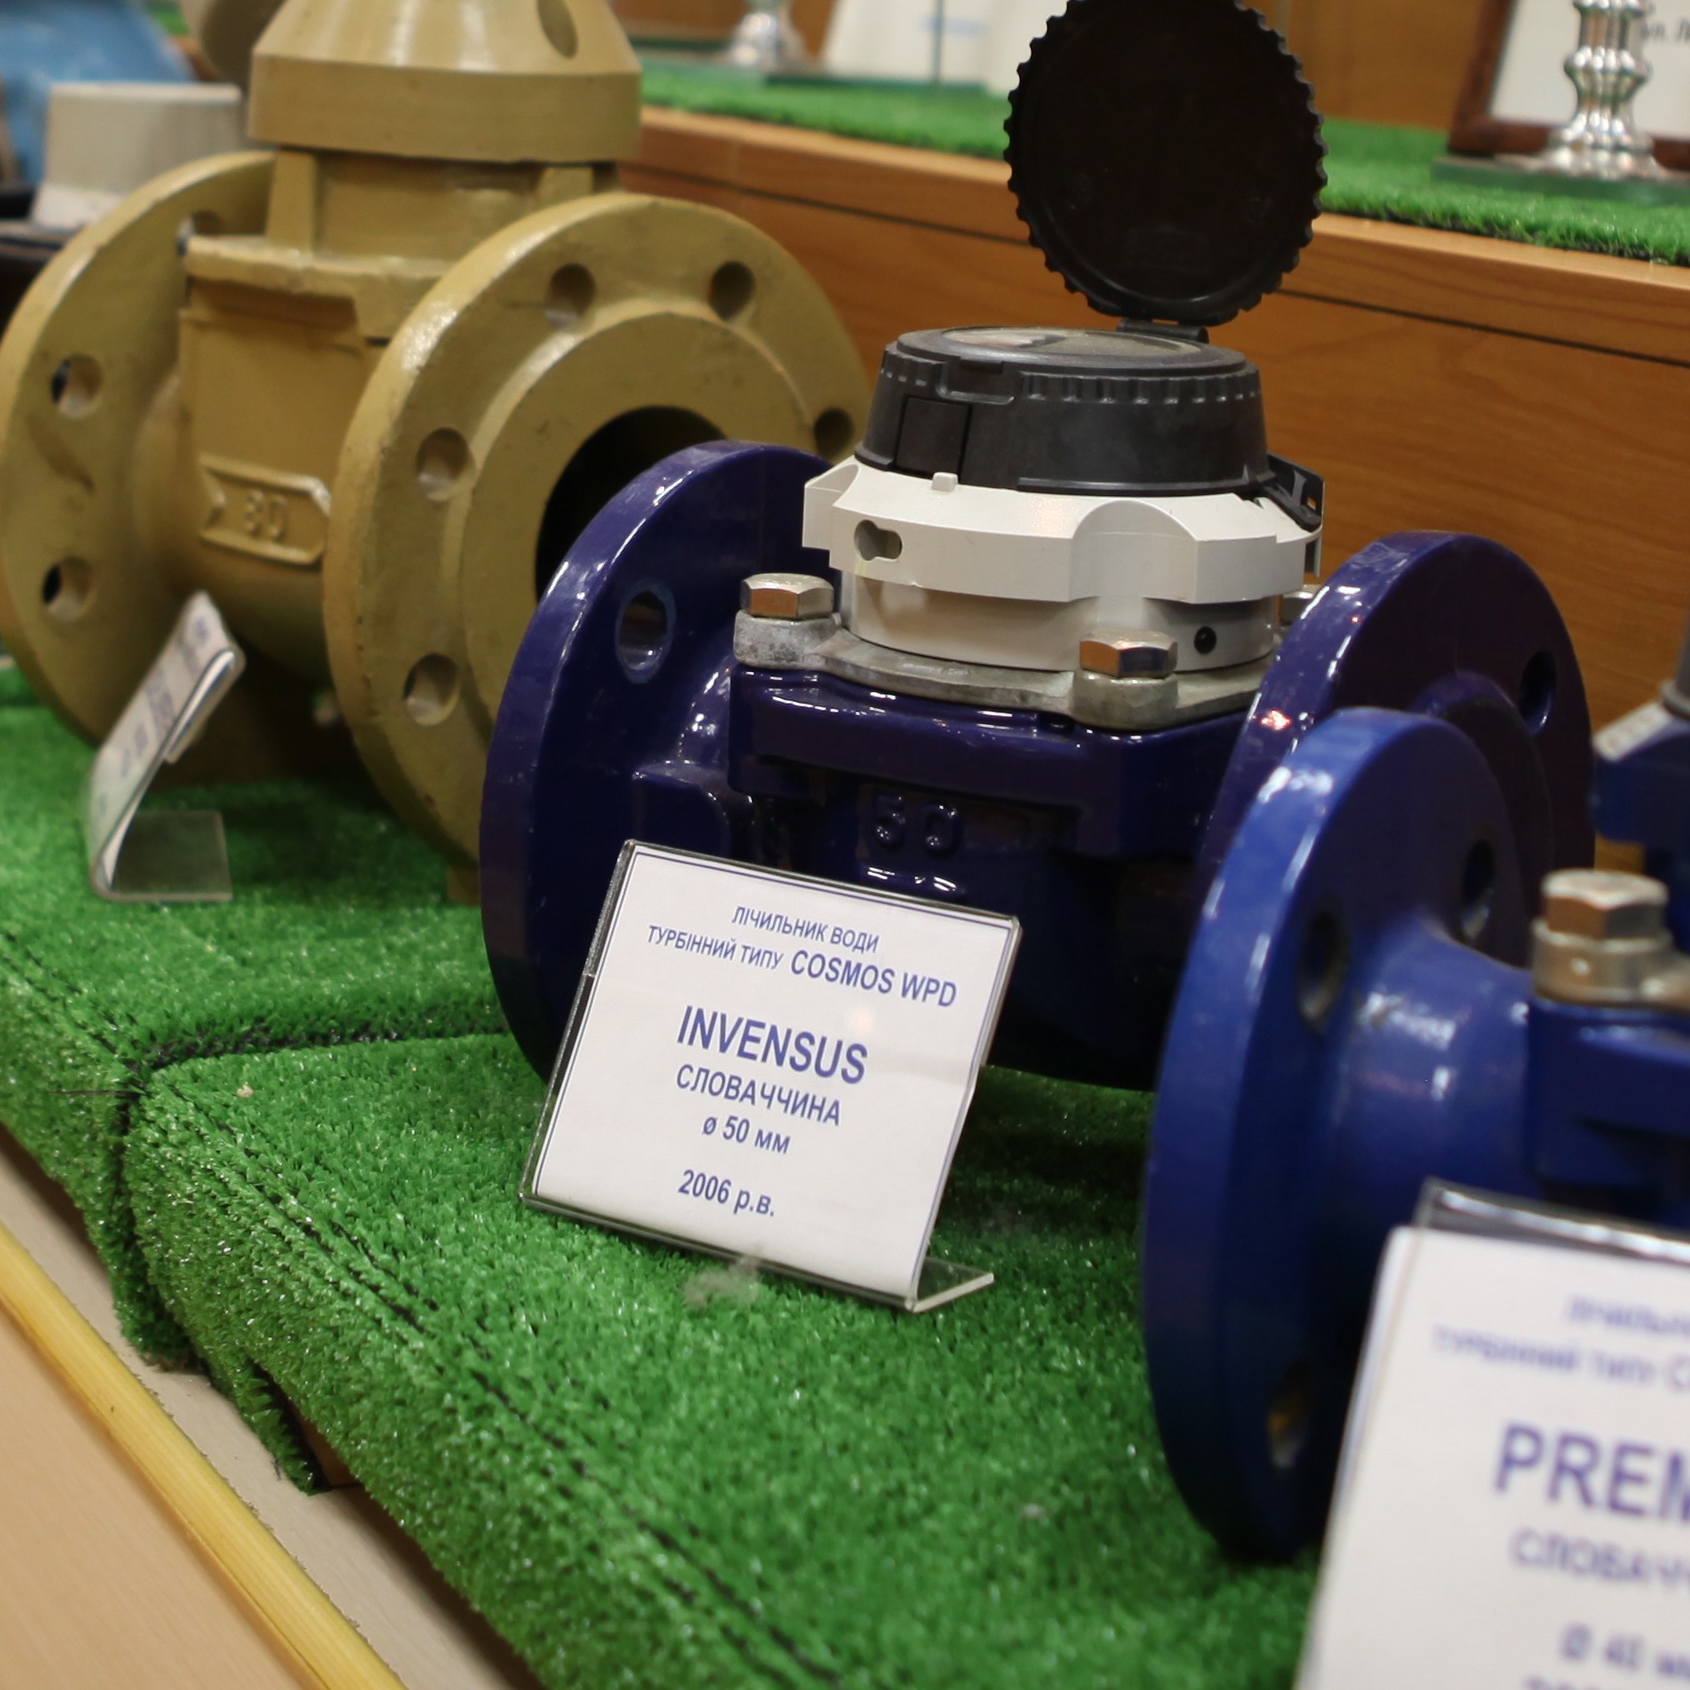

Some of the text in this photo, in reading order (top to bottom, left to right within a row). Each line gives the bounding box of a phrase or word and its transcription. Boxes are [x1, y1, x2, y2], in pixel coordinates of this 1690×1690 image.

[872, 793, 966, 861] 50
[731, 906, 880, 954] ЛІЧИЛЬНИК ВОДИ
[646, 924, 958, 1008] ТУРБІННИЙ ТИПУ COSMOS WPD
[676, 1004, 869, 1085] INVENSUS
[675, 1063, 842, 1127] СЛОВАЧЧИНА
[721, 1114, 750, 1144] 50
[678, 1168, 776, 1218] 2006 р.в.
